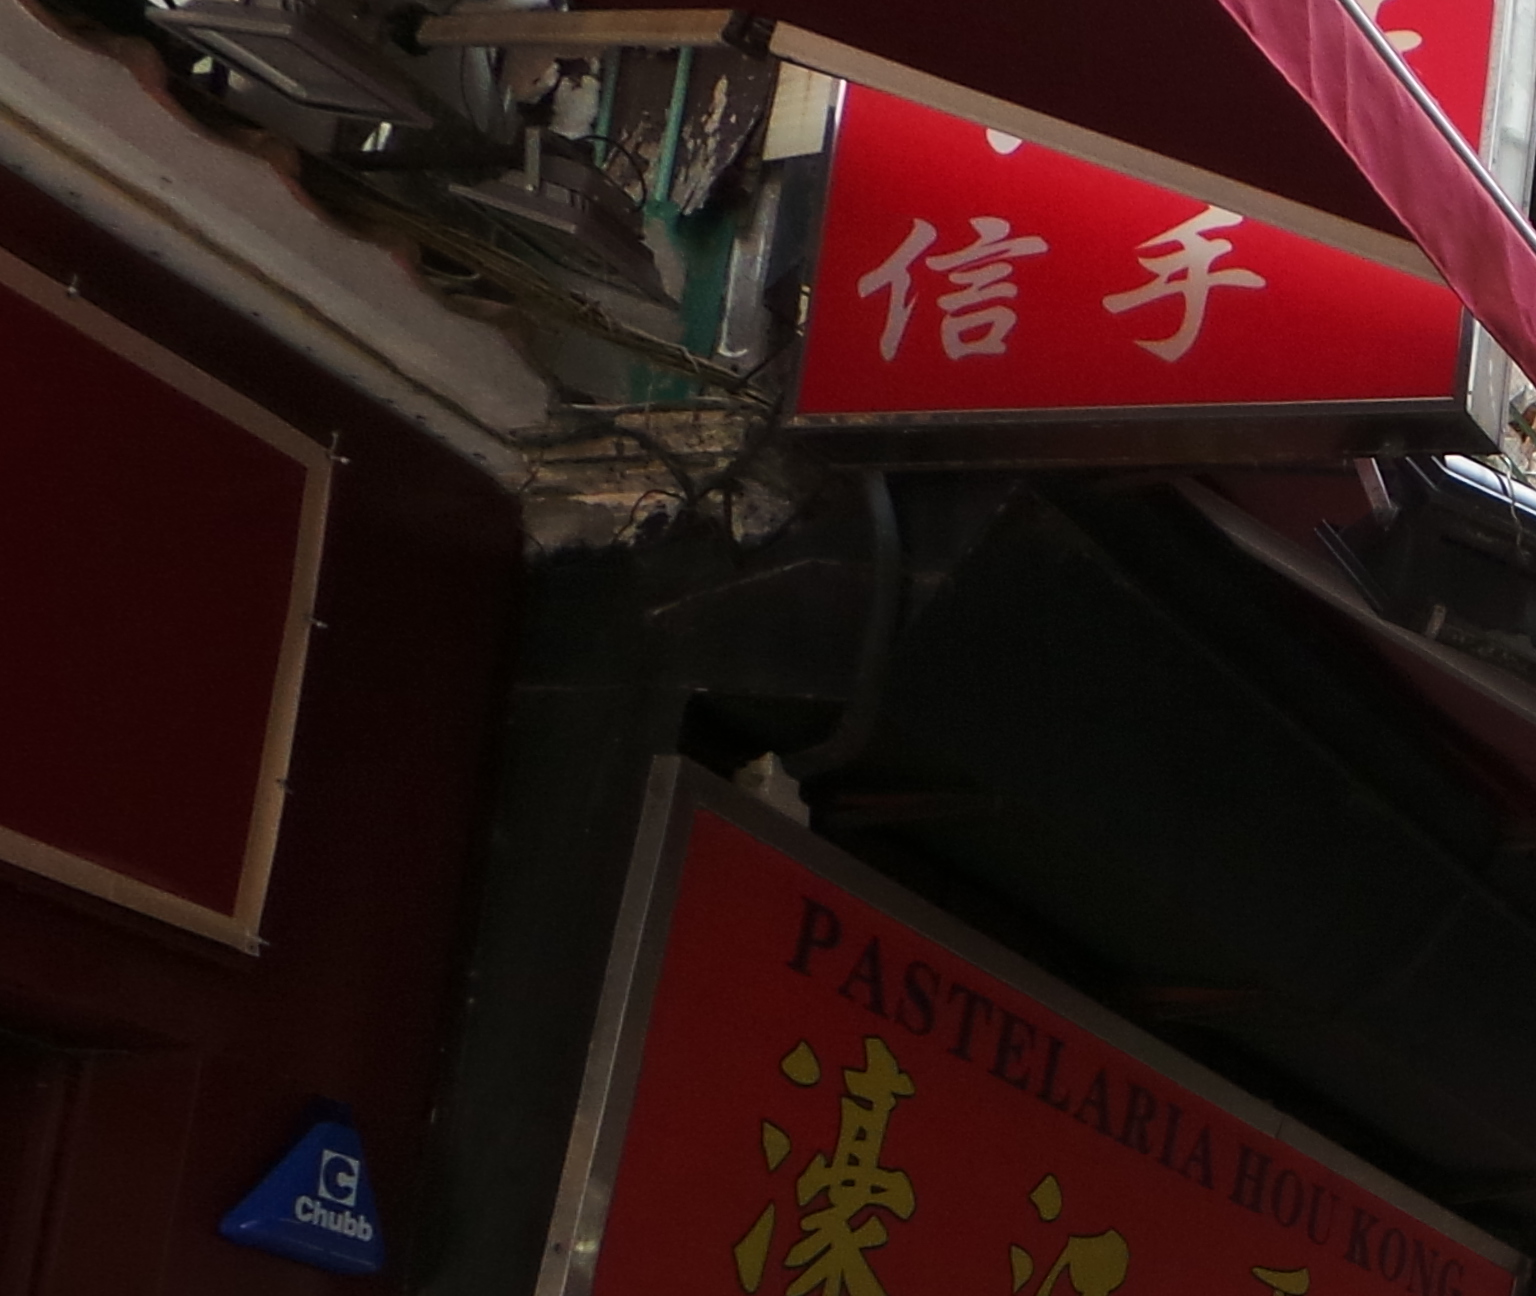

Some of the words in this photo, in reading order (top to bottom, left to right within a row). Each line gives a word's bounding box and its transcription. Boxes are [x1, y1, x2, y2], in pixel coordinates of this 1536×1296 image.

[784, 893, 1216, 1194] PASTELARIA
[1228, 1140, 1340, 1246] HOU
[294, 1195, 374, 1243] Chubb
